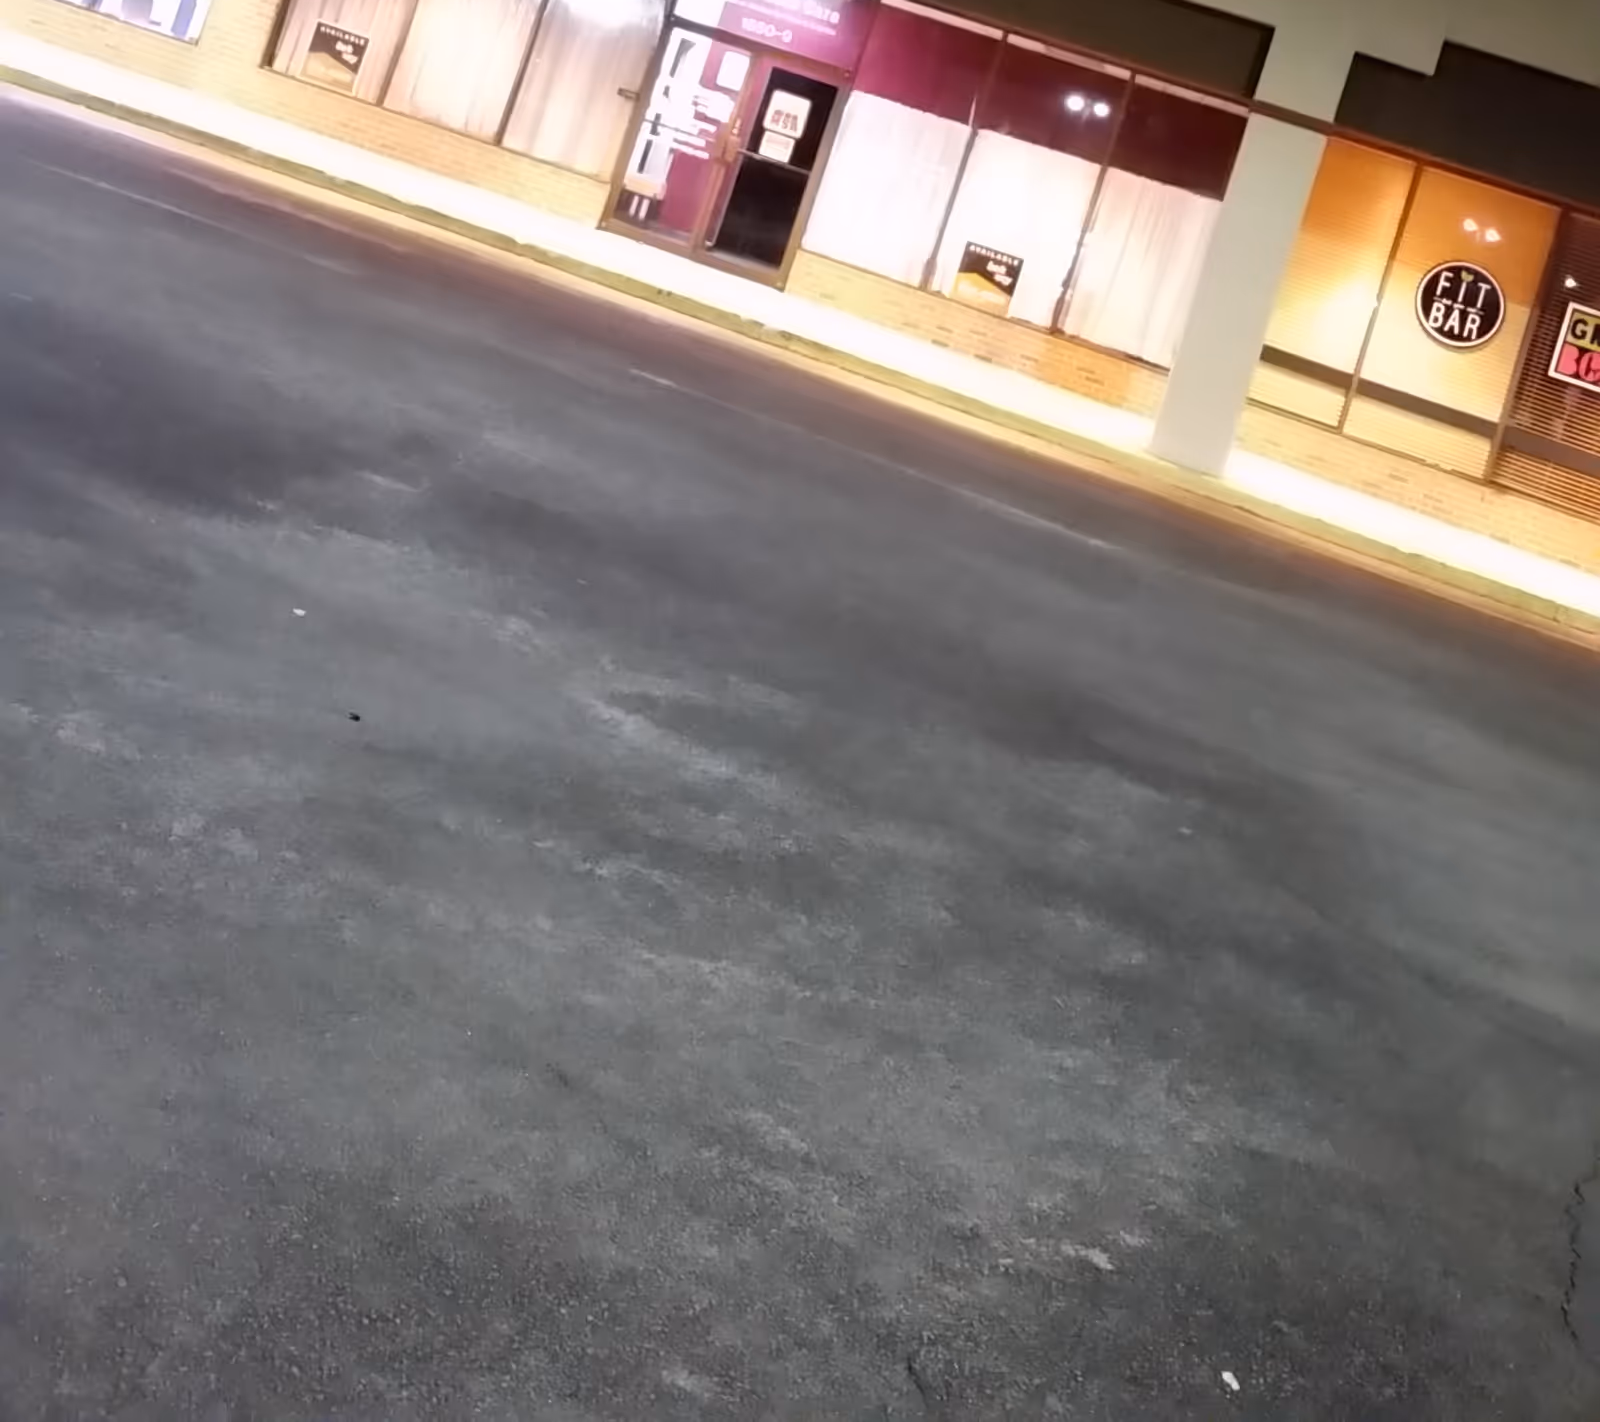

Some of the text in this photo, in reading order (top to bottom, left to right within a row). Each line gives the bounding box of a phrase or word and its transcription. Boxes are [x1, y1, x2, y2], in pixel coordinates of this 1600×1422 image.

[969, 244, 1019, 267] AVAILABLE
[1436, 270, 1492, 309] FIT
[1428, 301, 1481, 340] BAR
